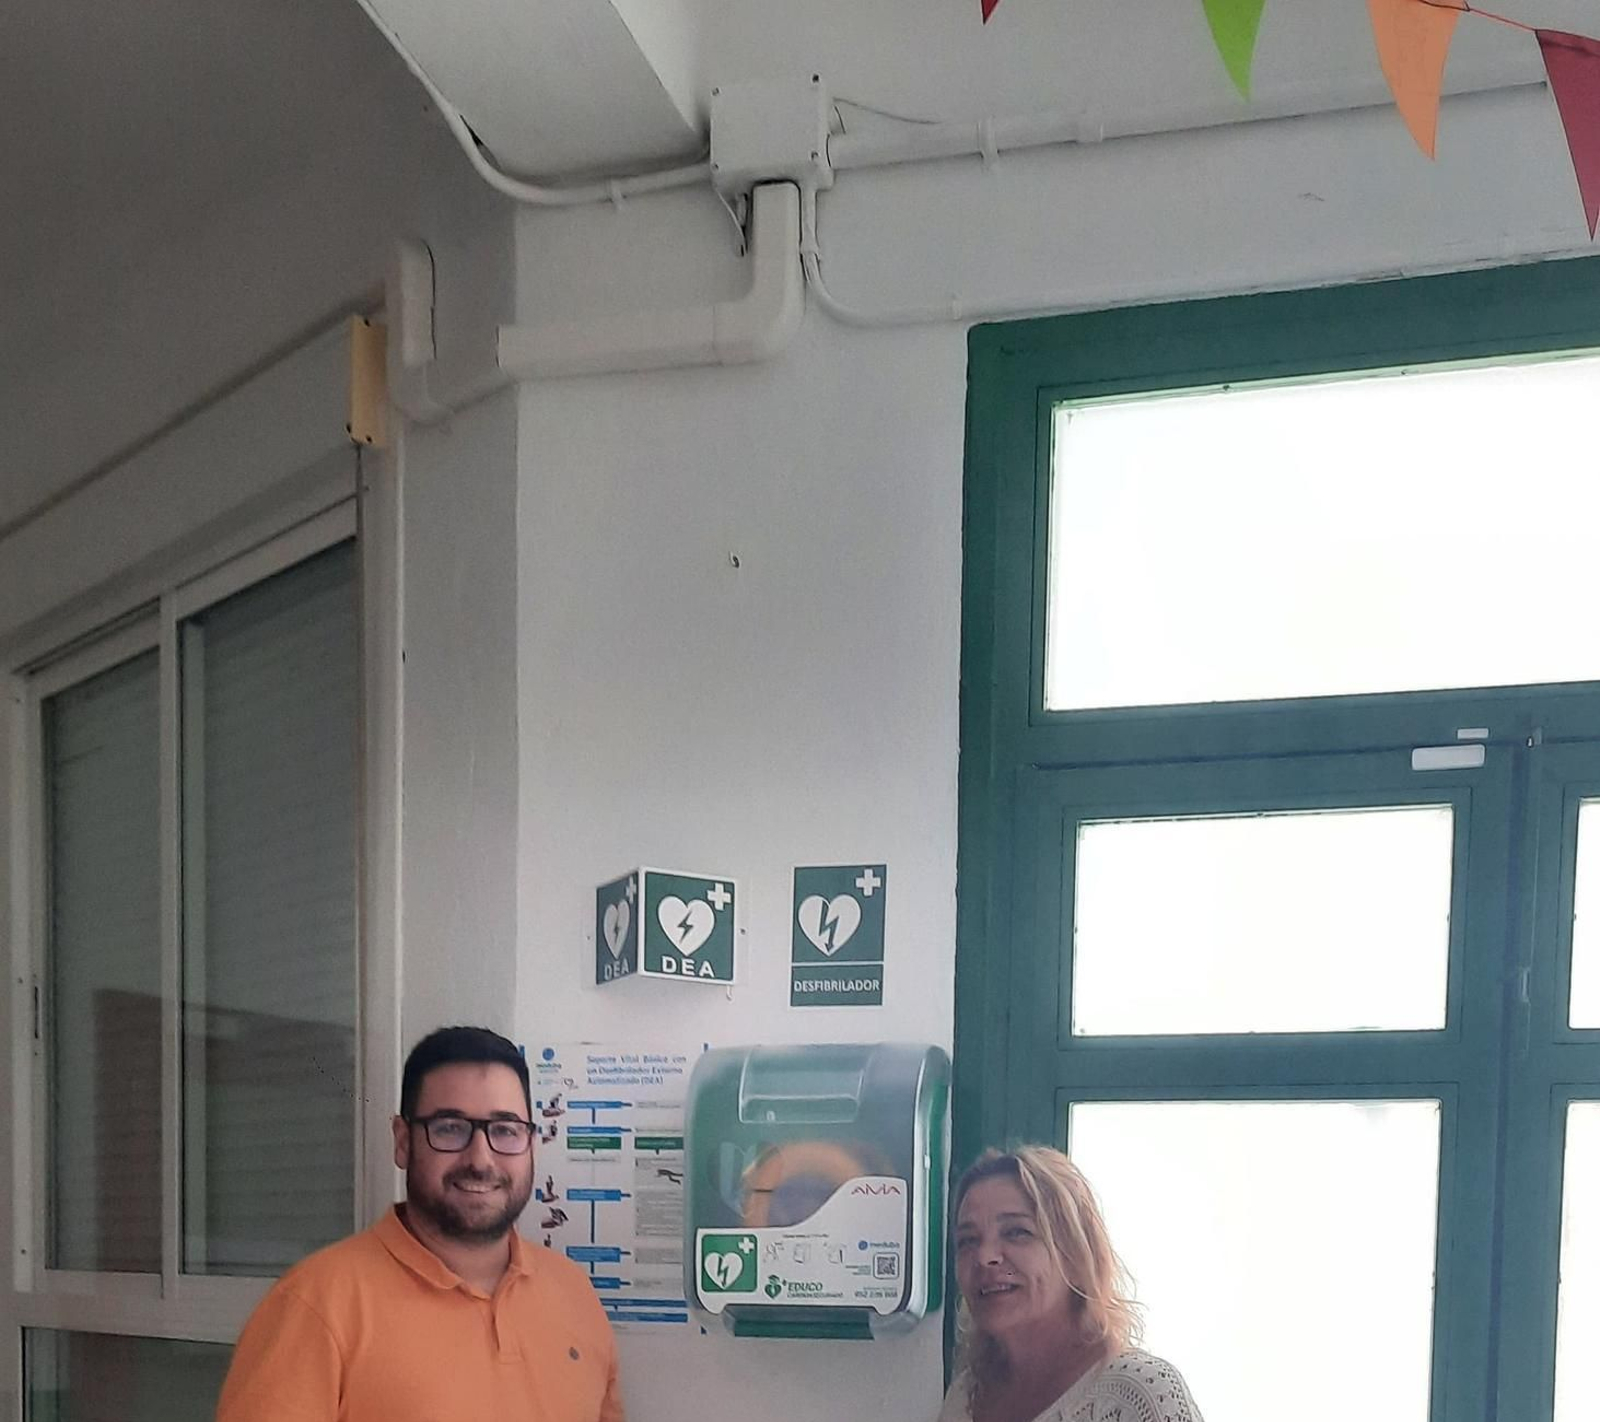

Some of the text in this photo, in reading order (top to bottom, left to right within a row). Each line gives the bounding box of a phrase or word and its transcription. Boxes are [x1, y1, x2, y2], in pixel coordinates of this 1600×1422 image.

[604, 960, 629, 981] DEA
[661, 955, 716, 978] DEA
[793, 979, 881, 994] DESFIBRILADOR
[787, 1281, 823, 1292] EDUCO
